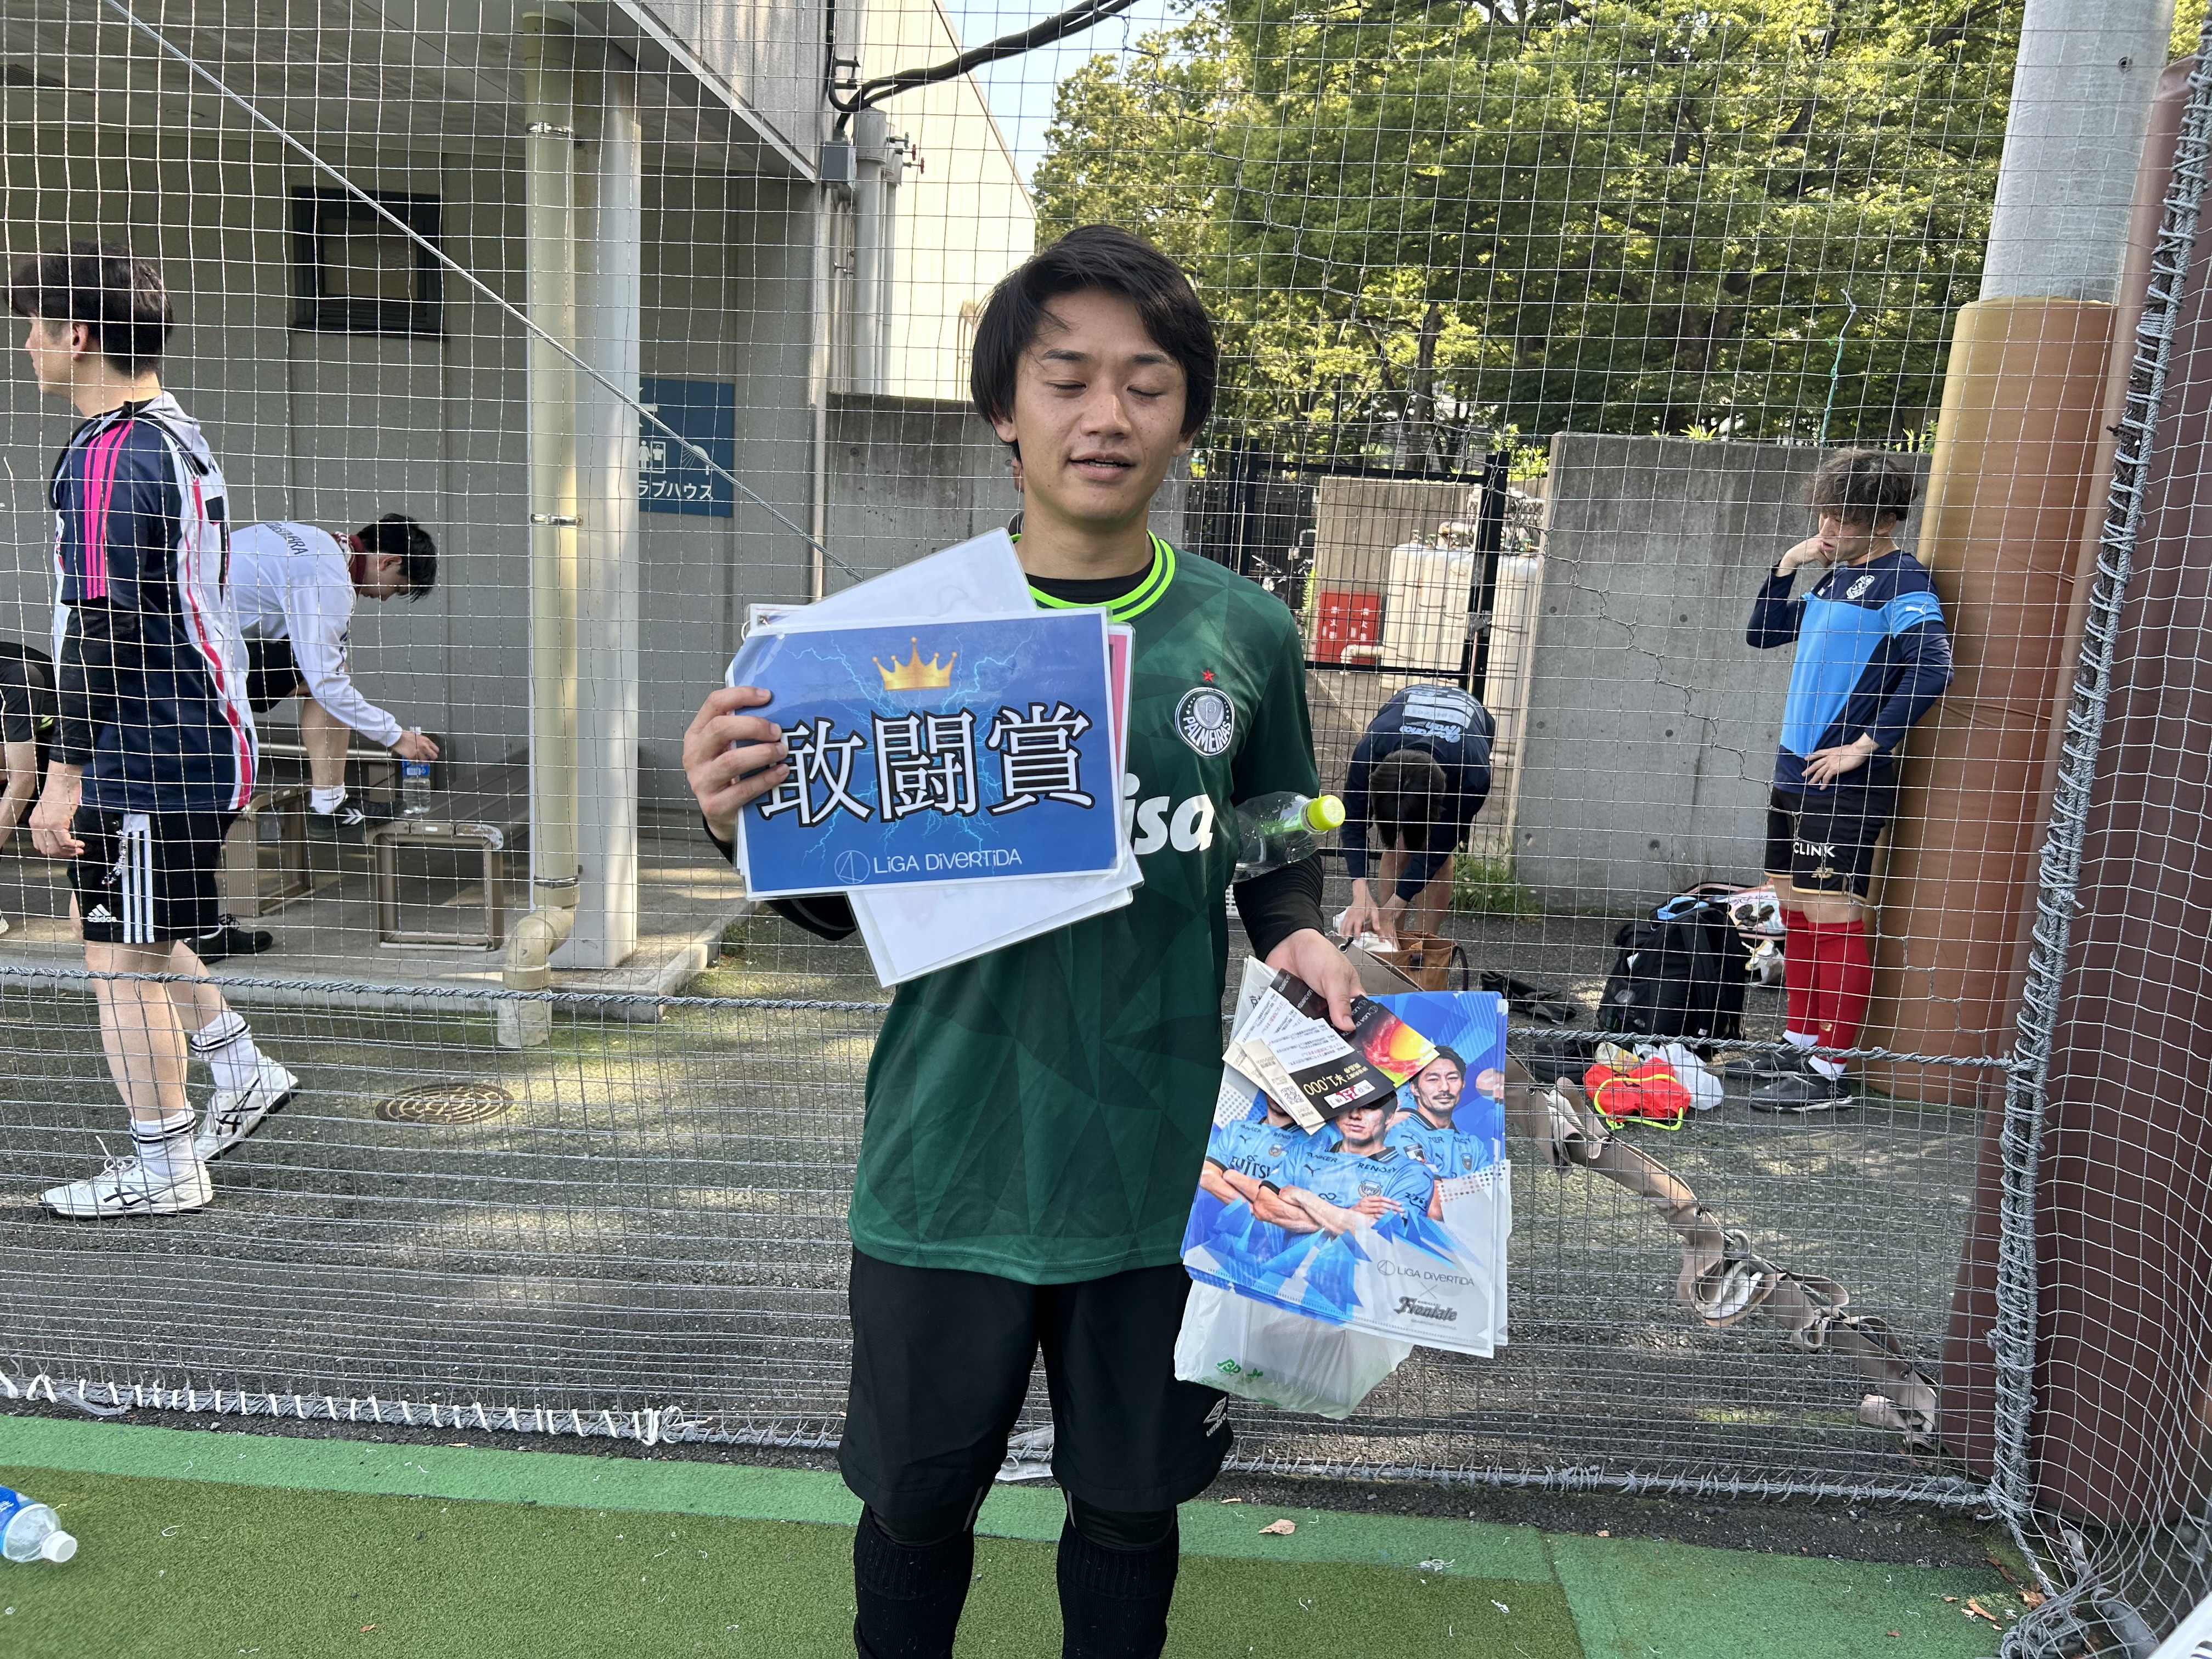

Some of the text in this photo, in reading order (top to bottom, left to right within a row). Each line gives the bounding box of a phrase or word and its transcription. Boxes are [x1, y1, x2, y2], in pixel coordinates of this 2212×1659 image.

[1183, 716, 1231, 752] PALMEIRAS
[757, 701, 1096, 827] 敢闘賞
[1793, 841, 1836, 858] CLINK
[1303, 1073, 1348, 1096] ¥1,000
[1306, 1152, 1338, 1163] ANKER
[1358, 1162, 1397, 1173] RENOSY
[1393, 1296, 1458, 1321] Frontale
[1206, 1412, 1227, 1437] umbro
